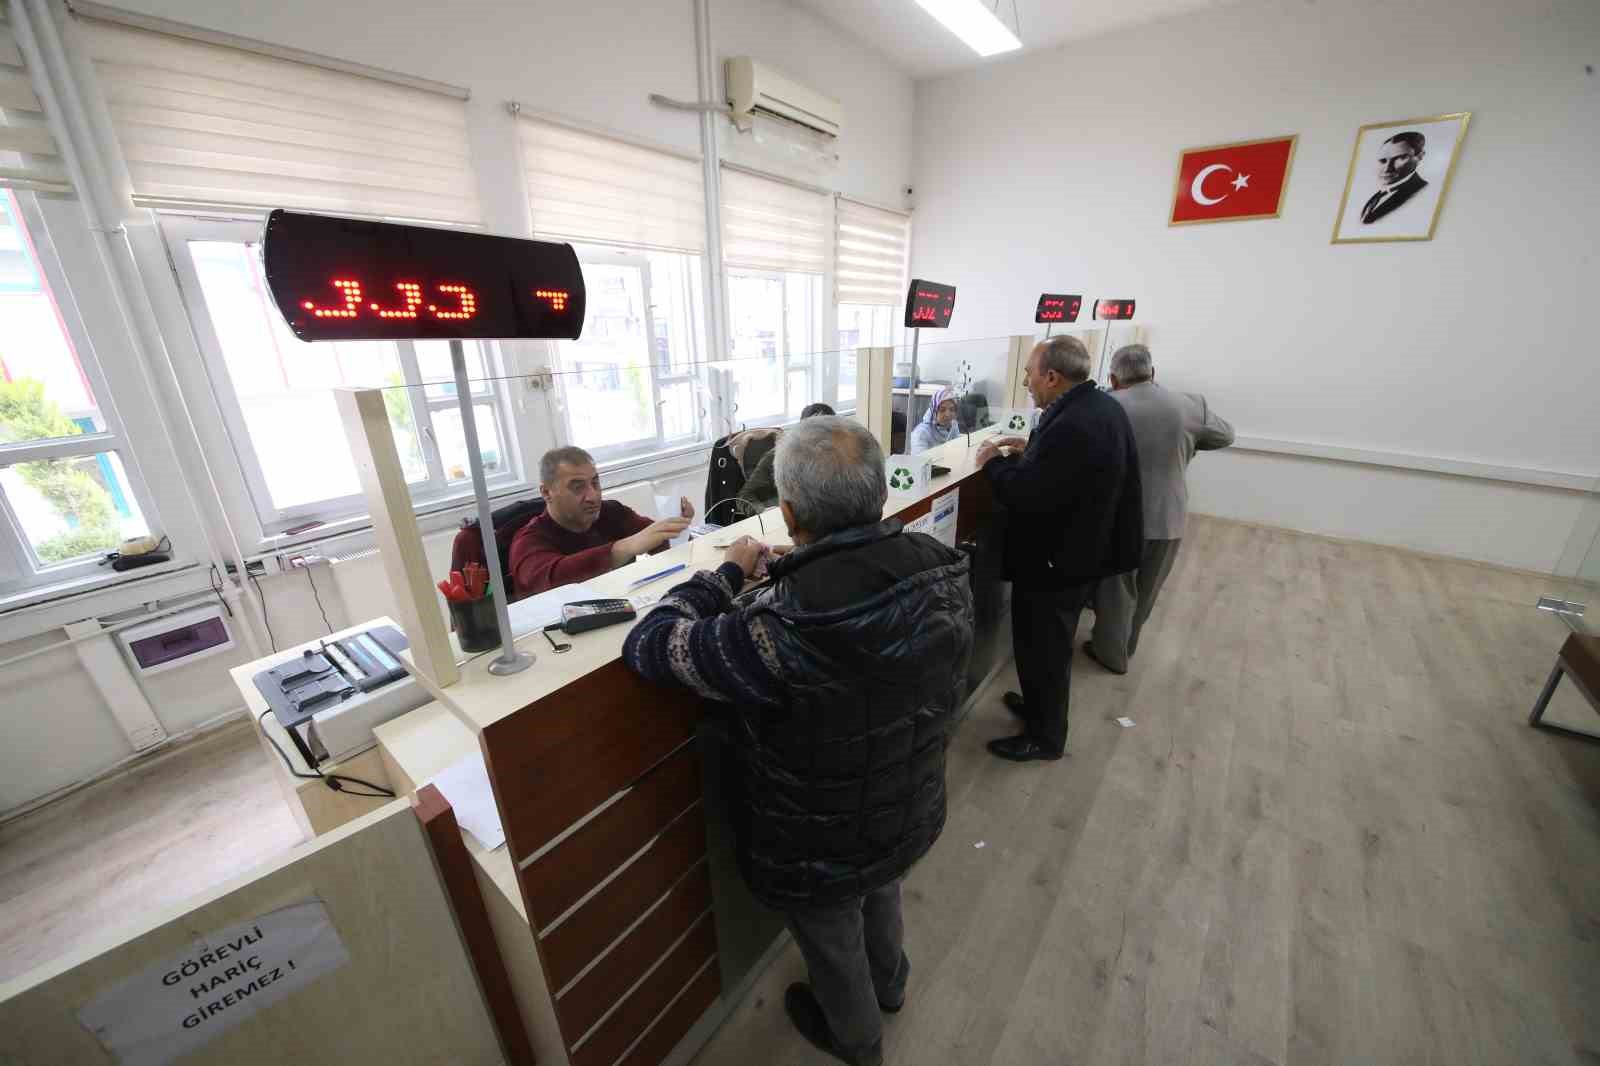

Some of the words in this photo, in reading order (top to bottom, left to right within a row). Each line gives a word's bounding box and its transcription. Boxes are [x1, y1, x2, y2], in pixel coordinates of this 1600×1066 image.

[162, 926, 263, 986] GÖREVLİ
[190, 956, 262, 999] HARİÇ
[182, 967, 284, 1028] GİREMEZ
